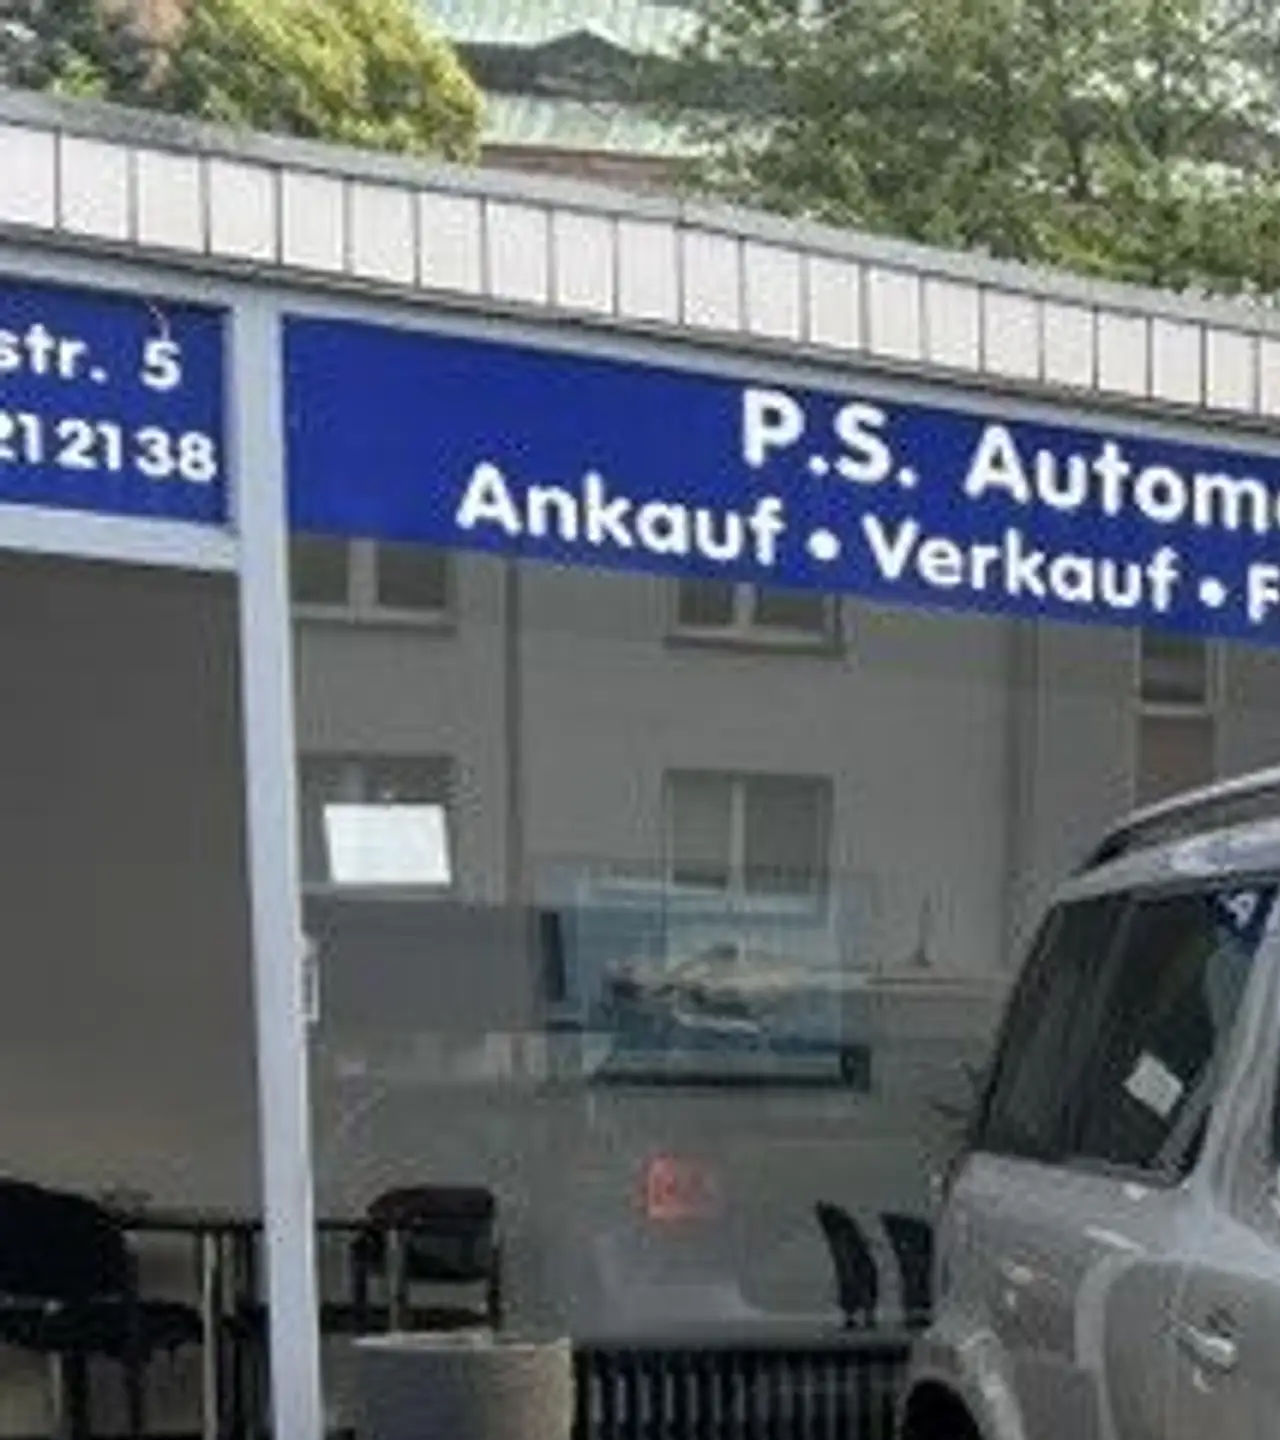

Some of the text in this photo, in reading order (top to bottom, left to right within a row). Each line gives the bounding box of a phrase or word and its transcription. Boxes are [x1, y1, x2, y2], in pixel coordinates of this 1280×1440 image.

[139, 338, 183, 392] 5
[743, 387, 919, 490] P.S.
[455, 460, 786, 567] Ankauf
[861, 511, 1181, 614] Verkauf
